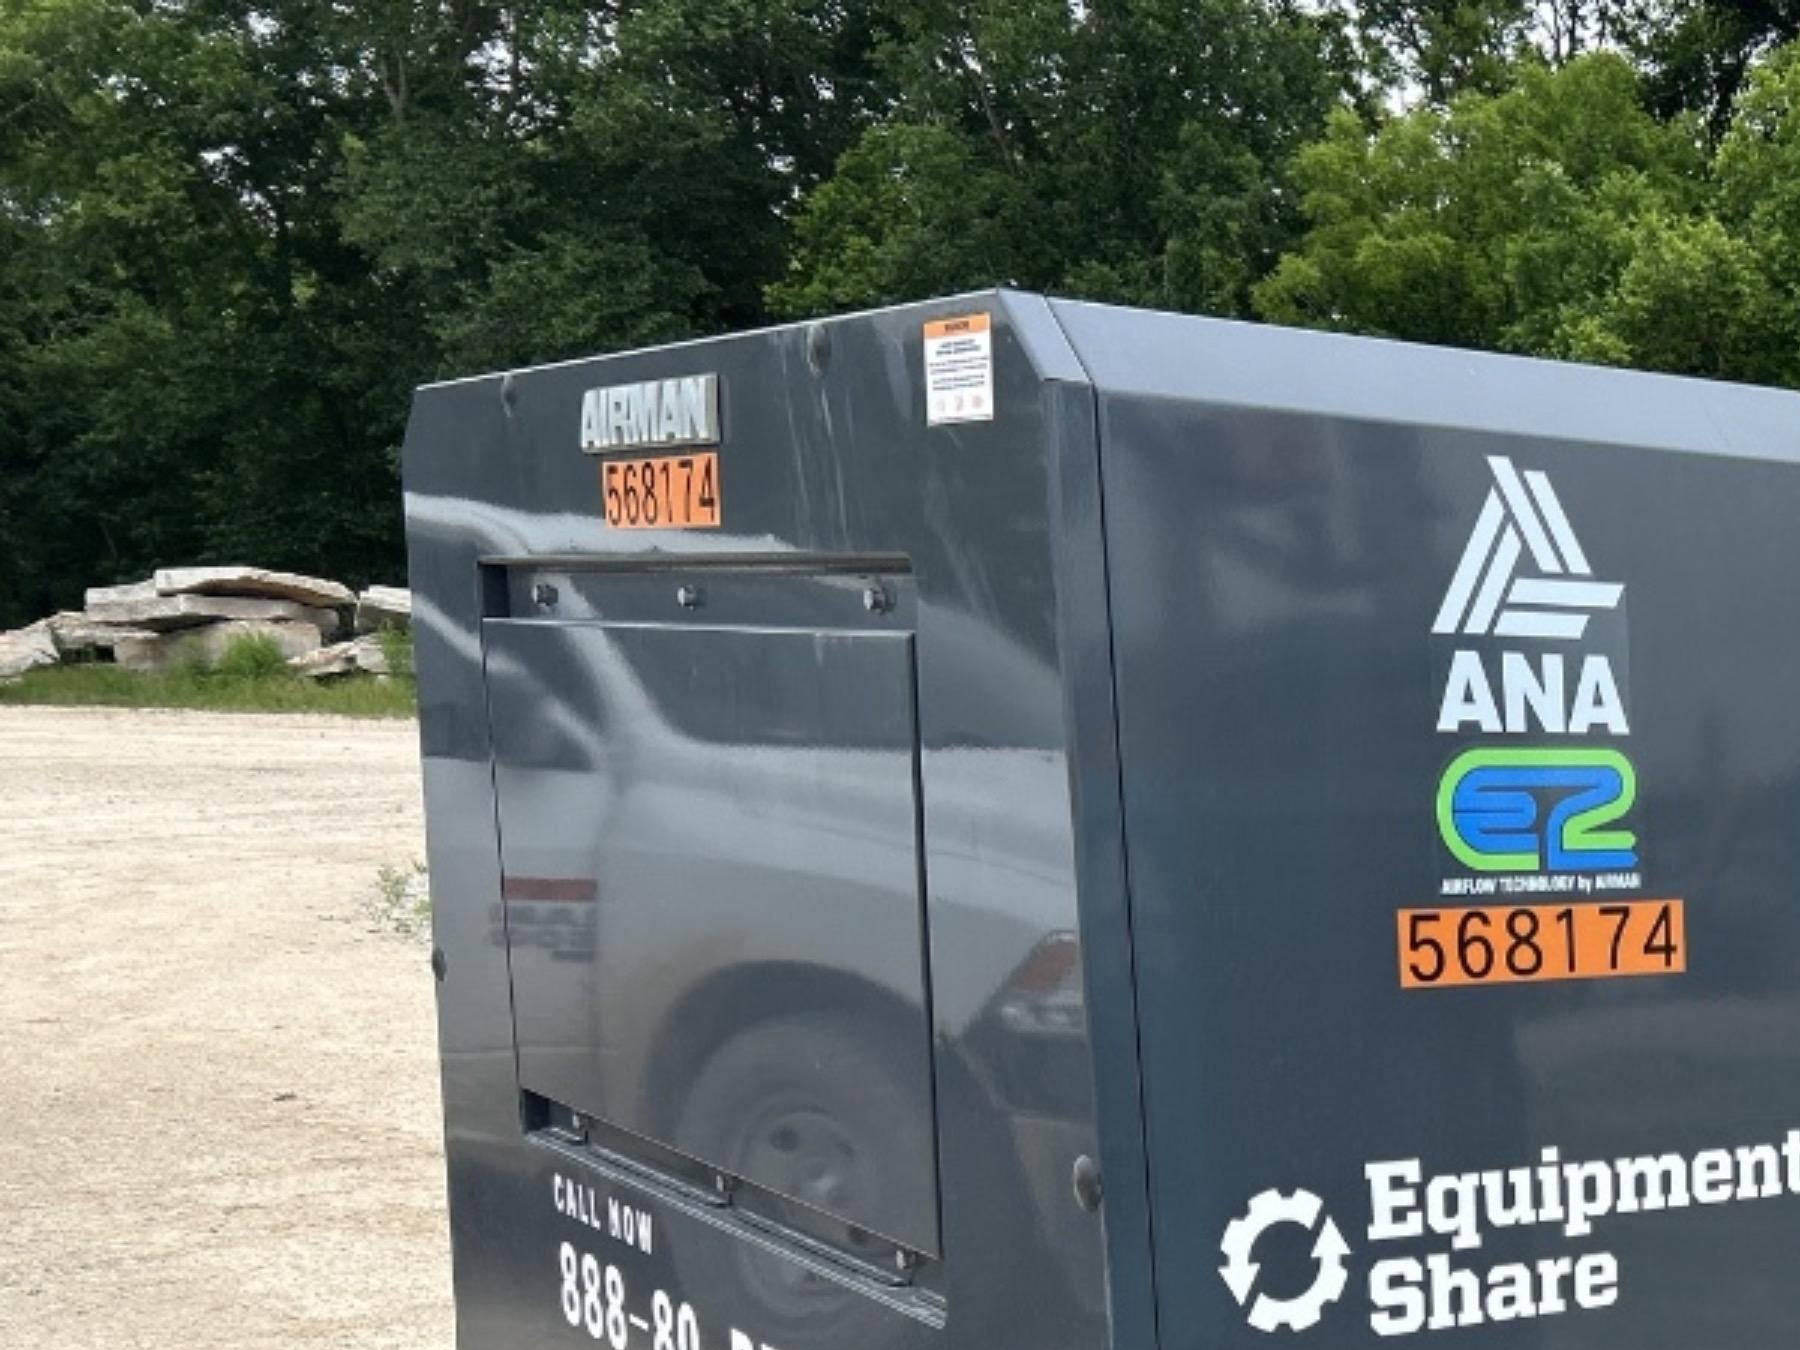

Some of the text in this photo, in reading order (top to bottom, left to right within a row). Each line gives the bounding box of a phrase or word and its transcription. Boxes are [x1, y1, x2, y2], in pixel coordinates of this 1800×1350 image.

[581, 372, 712, 450] AIRMAN
[606, 456, 716, 526] 568174
[1437, 650, 1631, 735] ANA
[1408, 902, 1678, 983] 568174
[553, 1172, 654, 1256] CALL NOW
[1368, 1252, 1618, 1337] Share
